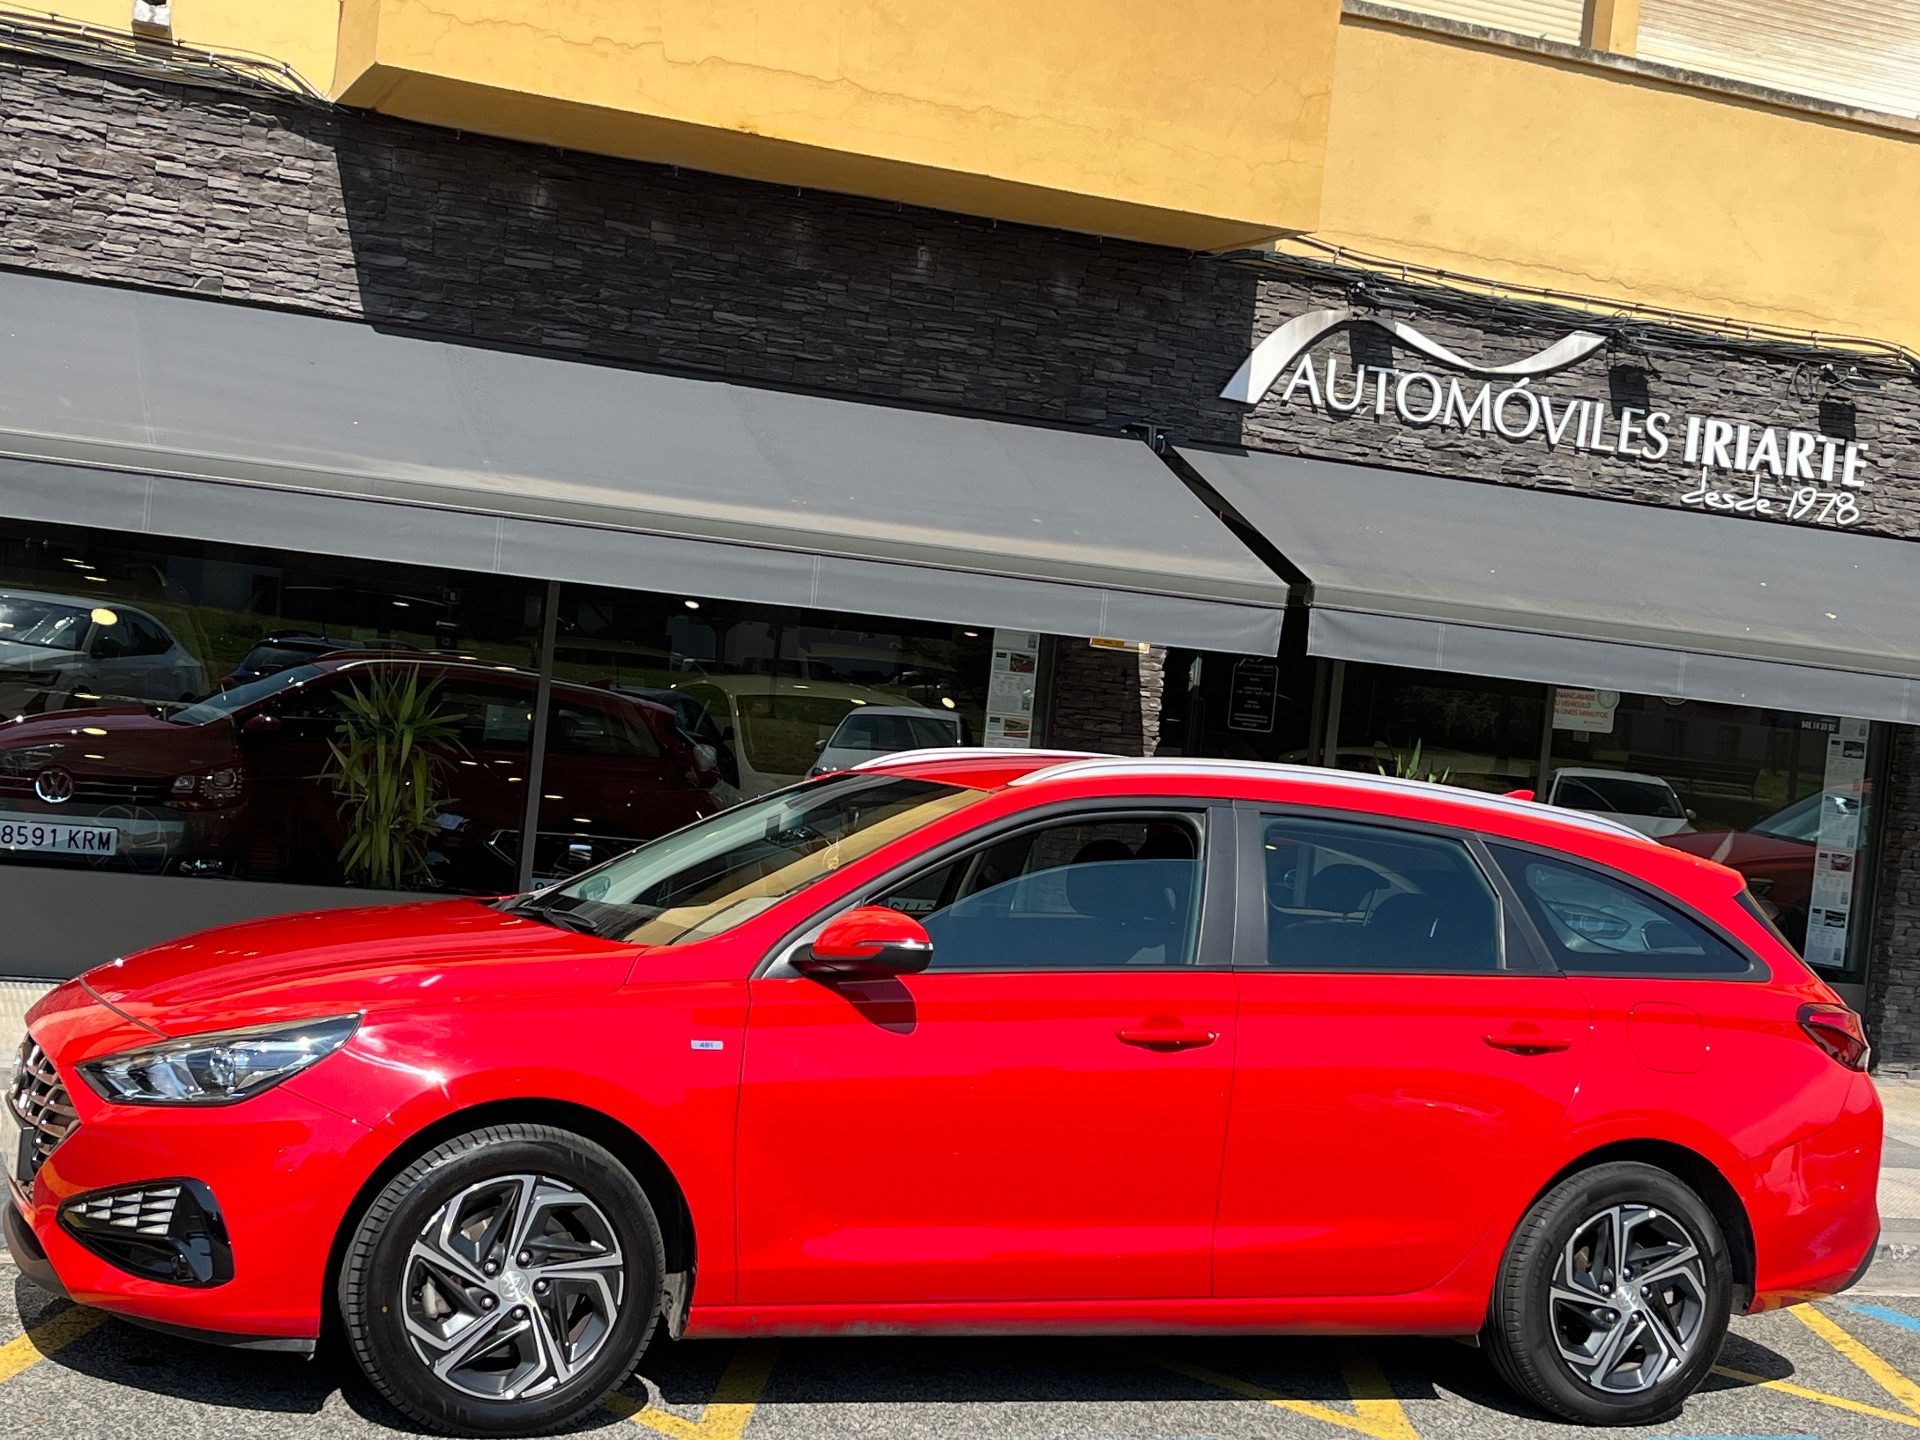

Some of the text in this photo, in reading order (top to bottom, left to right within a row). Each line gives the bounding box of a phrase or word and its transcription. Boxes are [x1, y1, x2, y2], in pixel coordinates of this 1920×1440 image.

[1281, 353, 1869, 488] AUTOMÓVILES IRIARTE
[1680, 466, 1860, 526] desde 1978
[1, 825, 112, 851] 8591 KRM
